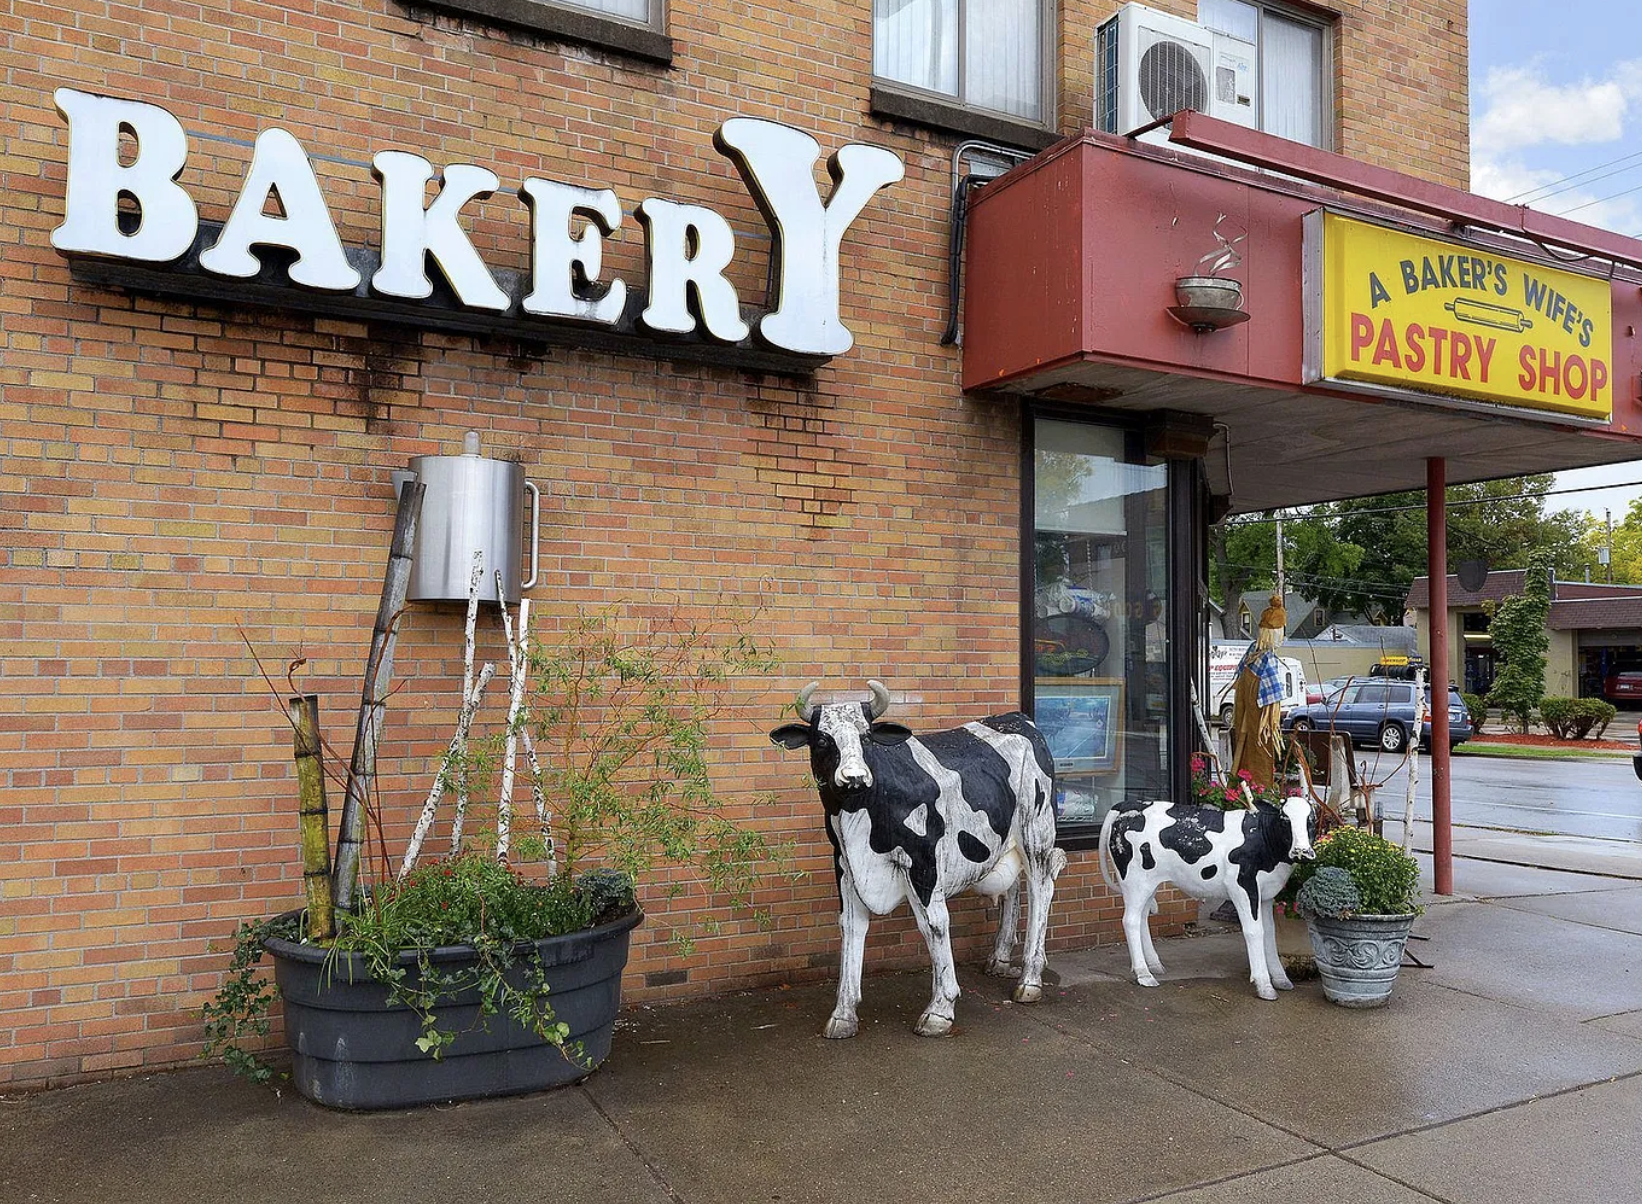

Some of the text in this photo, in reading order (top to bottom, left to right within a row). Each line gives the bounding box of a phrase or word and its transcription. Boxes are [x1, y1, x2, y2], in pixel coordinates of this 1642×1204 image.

[51, 86, 906, 357] BAKERY
[1369, 253, 1594, 348] A BAKER'S WIFE'S
[1350, 312, 1608, 402] PASTRY SHOP
